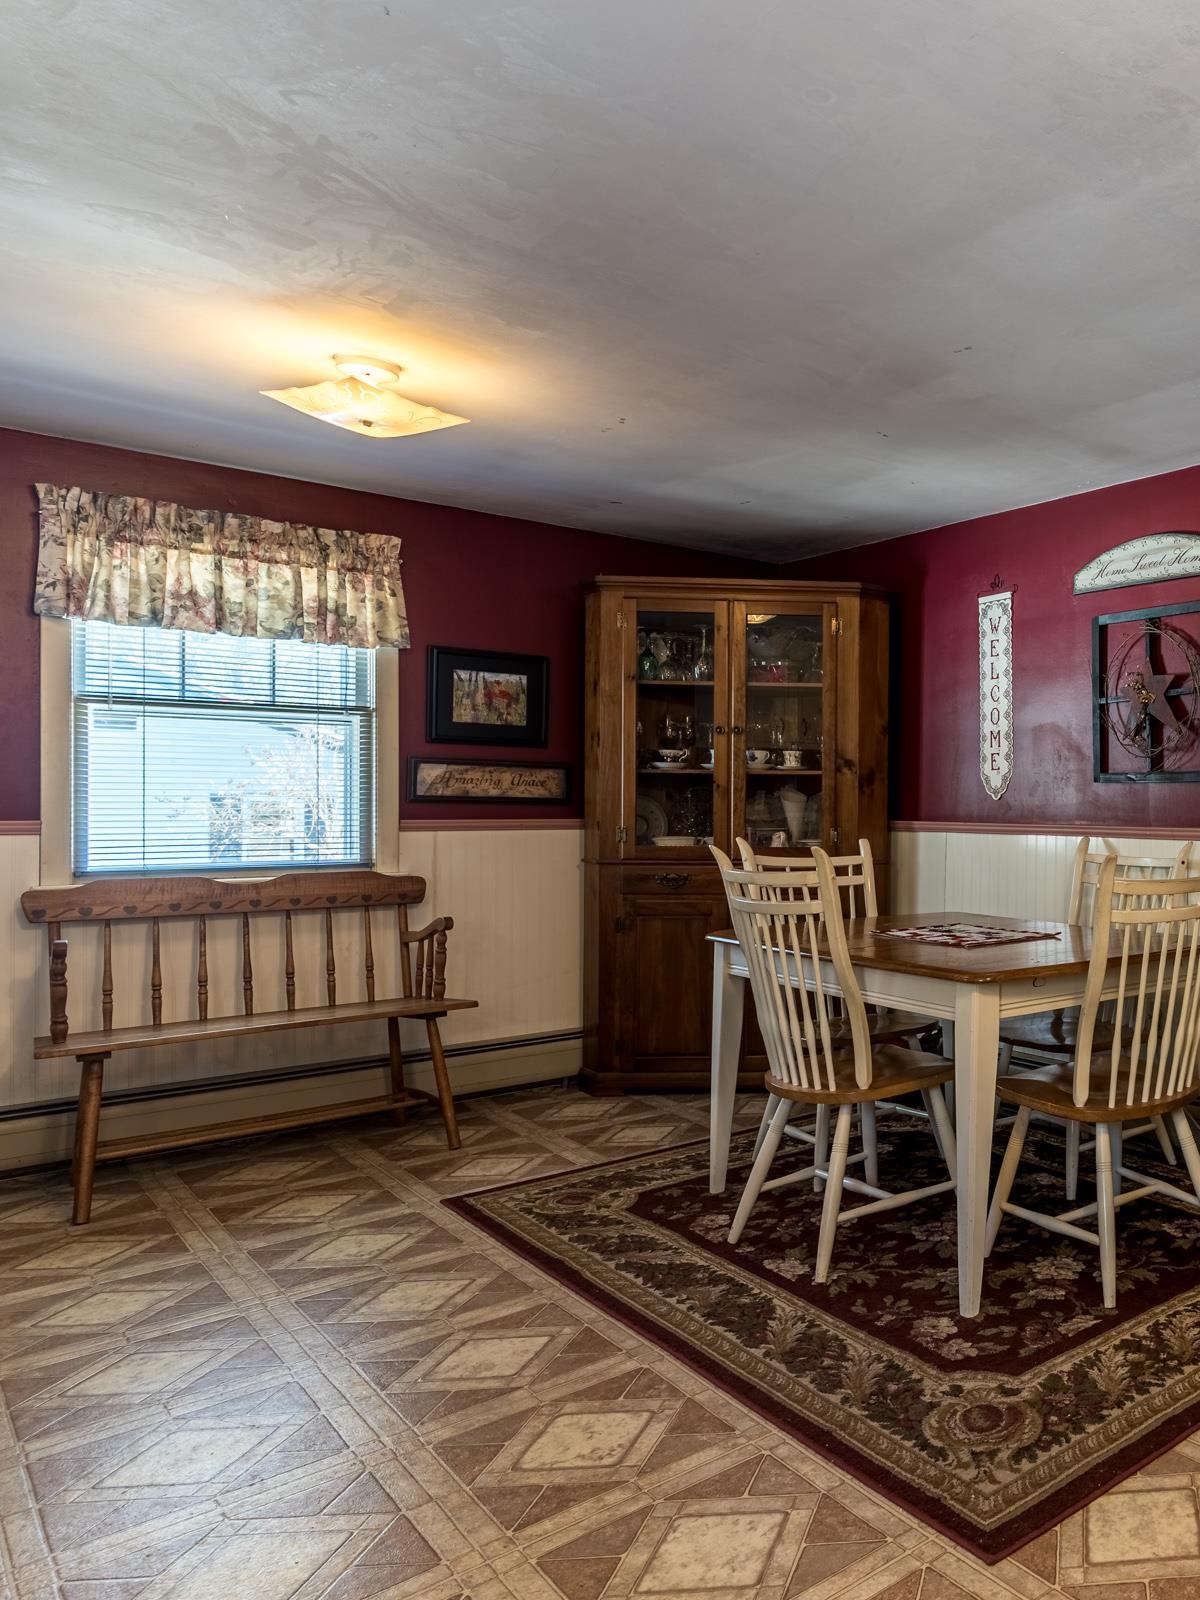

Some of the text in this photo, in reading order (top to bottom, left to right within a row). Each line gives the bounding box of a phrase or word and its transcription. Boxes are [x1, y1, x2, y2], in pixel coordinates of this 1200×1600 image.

[1093, 560, 1127, 581] Home
[1128, 553, 1166, 573] Sweet
[989, 617, 1002, 771] WELCOME
[433, 770, 547, 787] Amazing Grace
